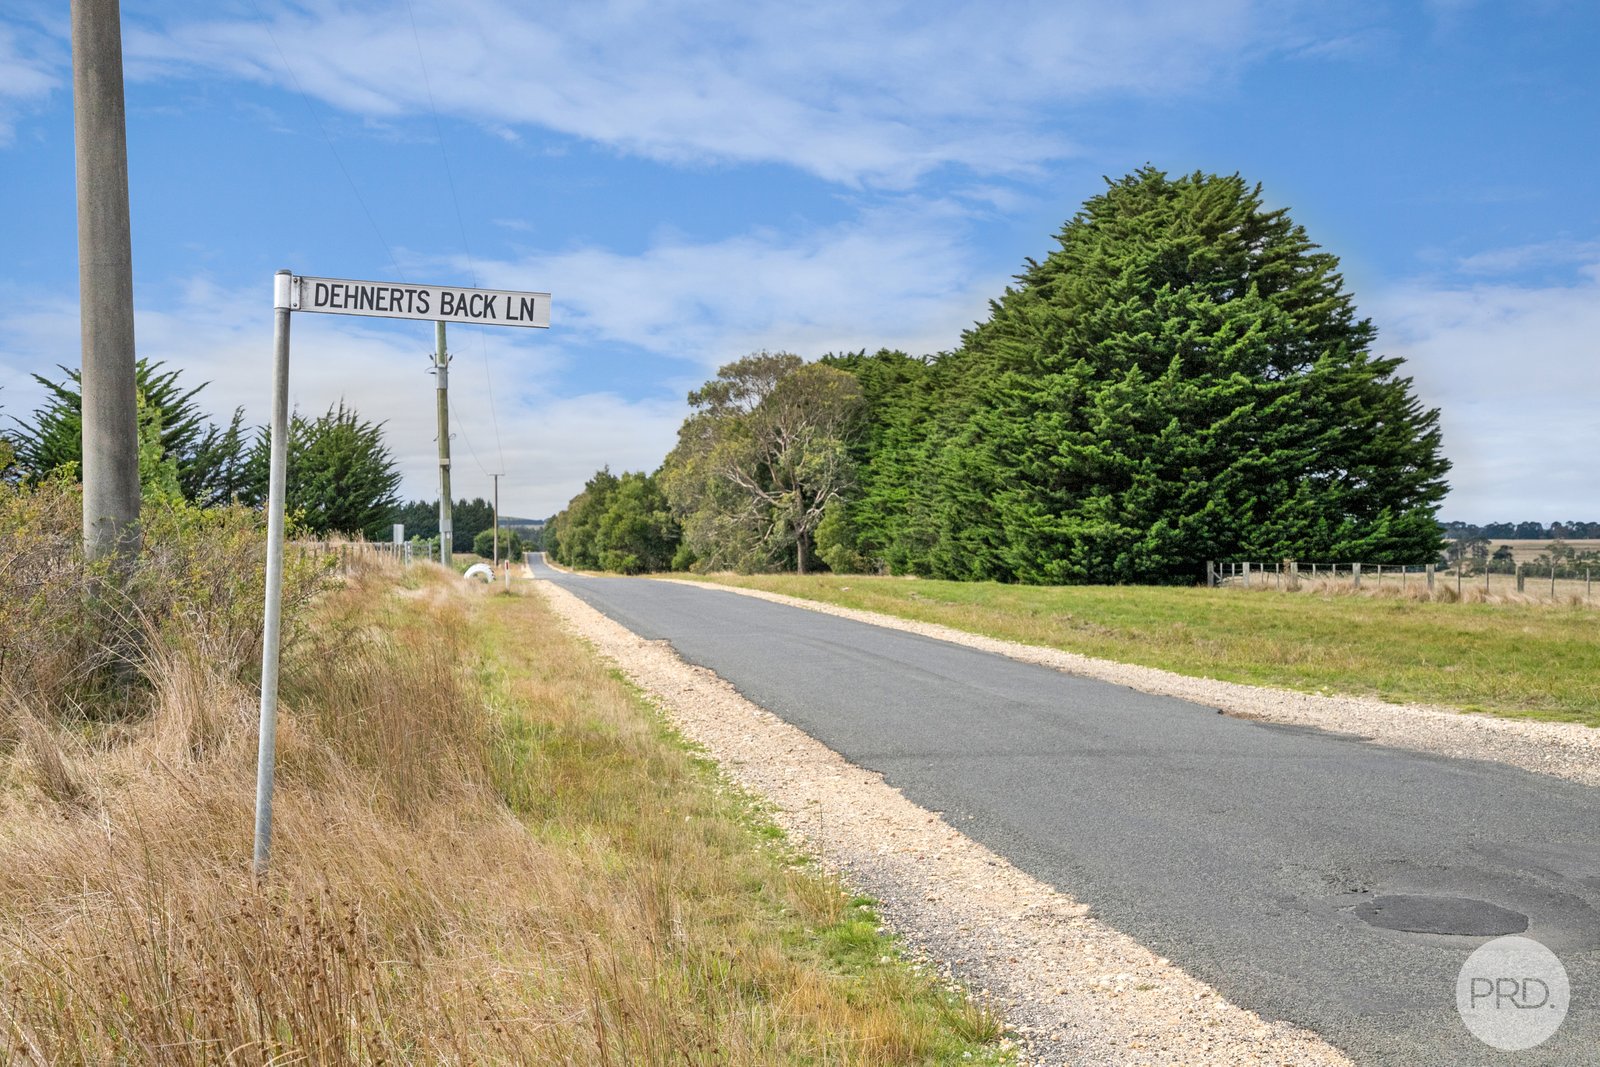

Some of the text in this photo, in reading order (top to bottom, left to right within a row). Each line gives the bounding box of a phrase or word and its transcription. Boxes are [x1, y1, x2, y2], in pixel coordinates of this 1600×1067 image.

[314, 282, 535, 322] DEHNERTS BACK LN
